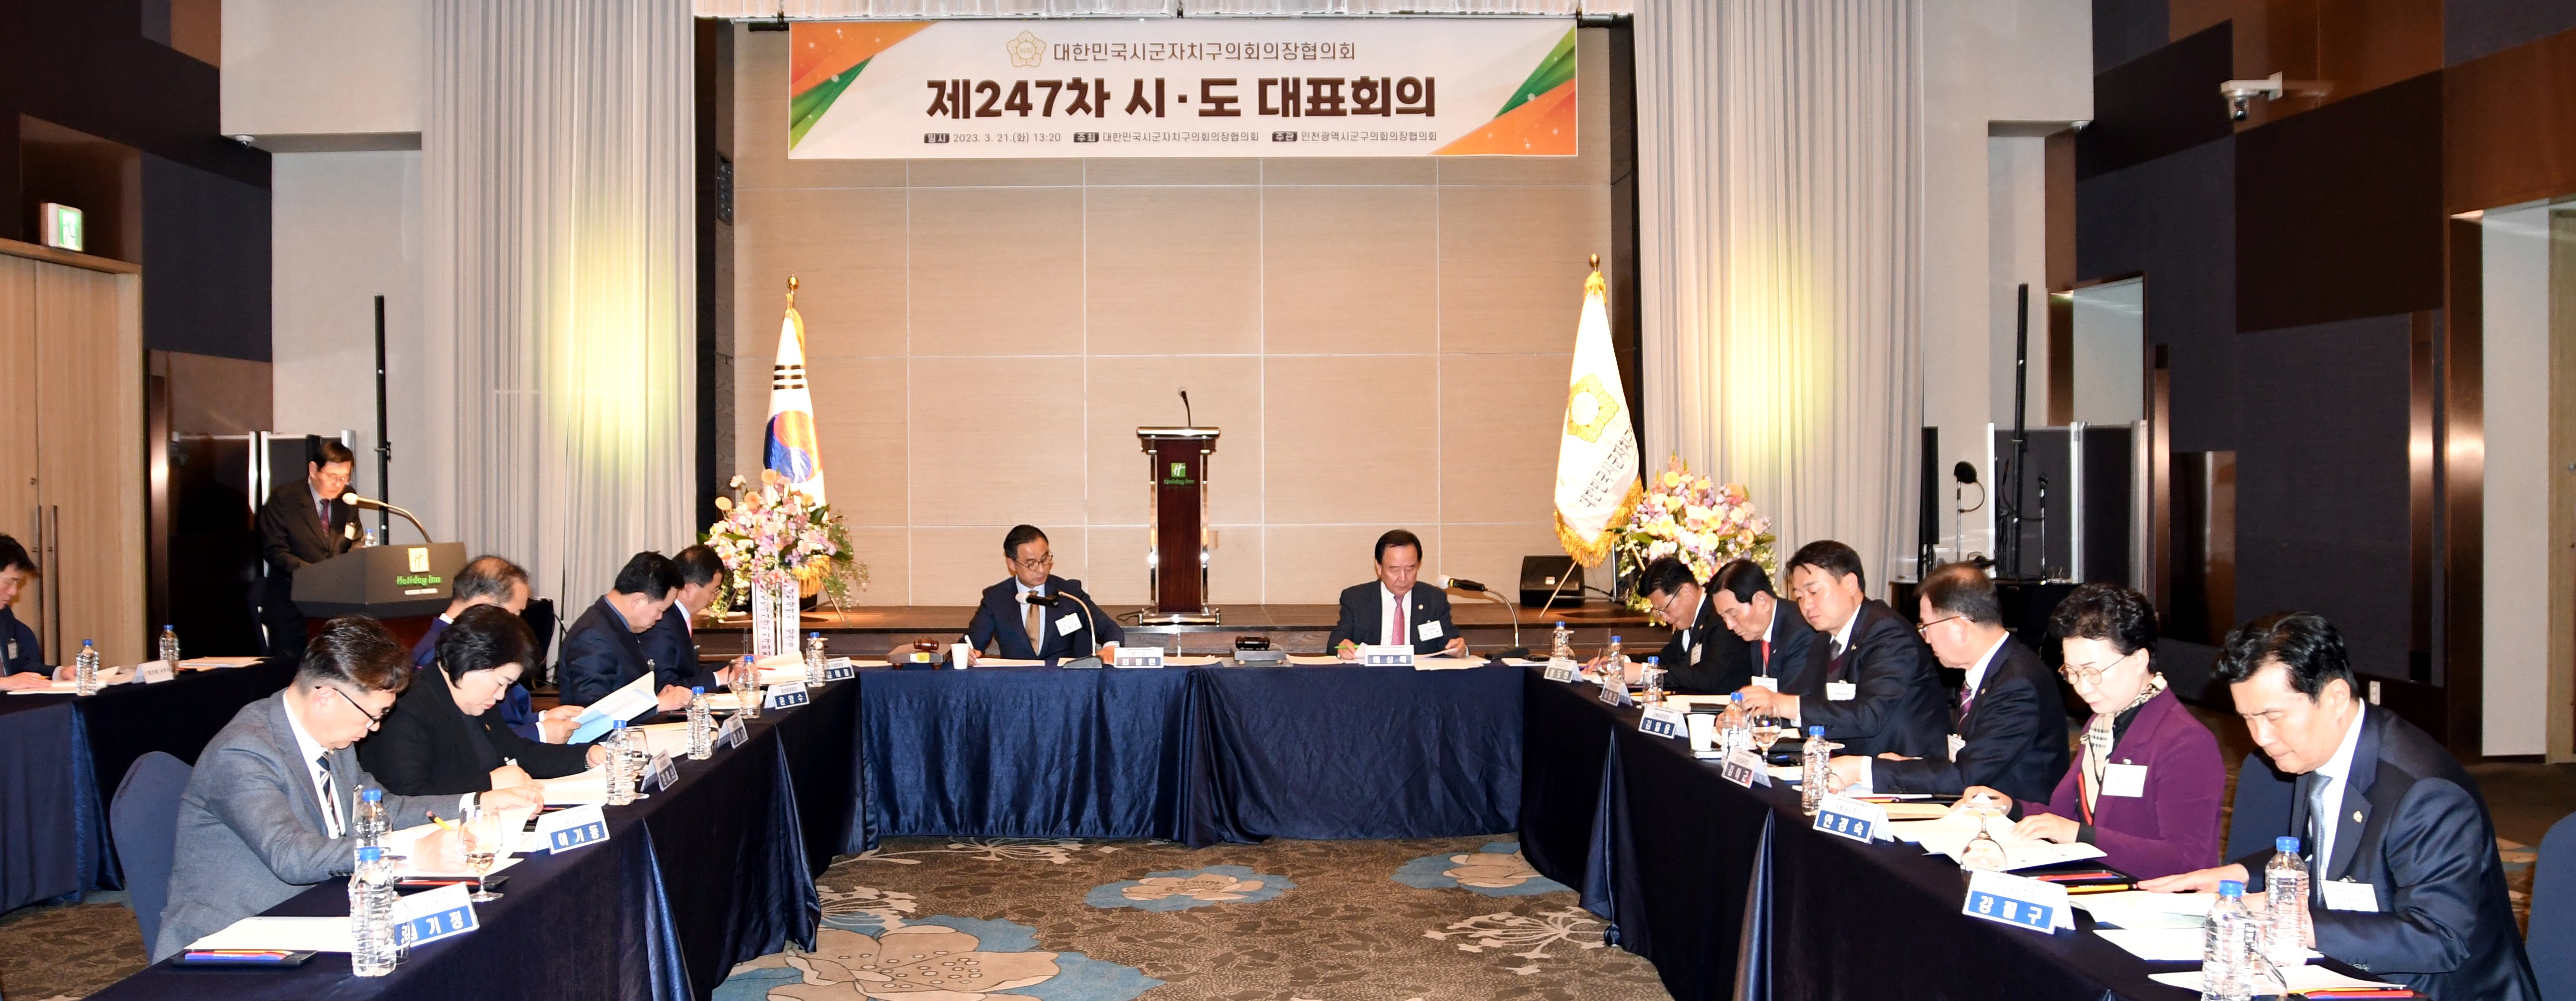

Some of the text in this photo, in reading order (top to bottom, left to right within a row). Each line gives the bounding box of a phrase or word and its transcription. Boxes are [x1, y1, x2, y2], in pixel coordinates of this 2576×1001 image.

[1053, 42, 1355, 62] 대한민국시군자치구의회의장협의회
[926, 77, 1111, 119] 제247차
[1258, 76, 1435, 117] 대표회의
[928, 134, 946, 143] 일시
[953, 134, 981, 142] 2023.
[985, 134, 993, 142] 3.
[1034, 133, 1061, 142] 13:20
[1077, 133, 1097, 142] 주최
[1103, 132, 1259, 142] 대한민국시군자치구의회의장협의회
[1276, 132, 1294, 141] 주관
[1301, 131, 1437, 141] 인천광역시군구의회의장협의회
[396, 575, 442, 586] Holiday Inn
[1822, 813, 1864, 836] 안경숙
